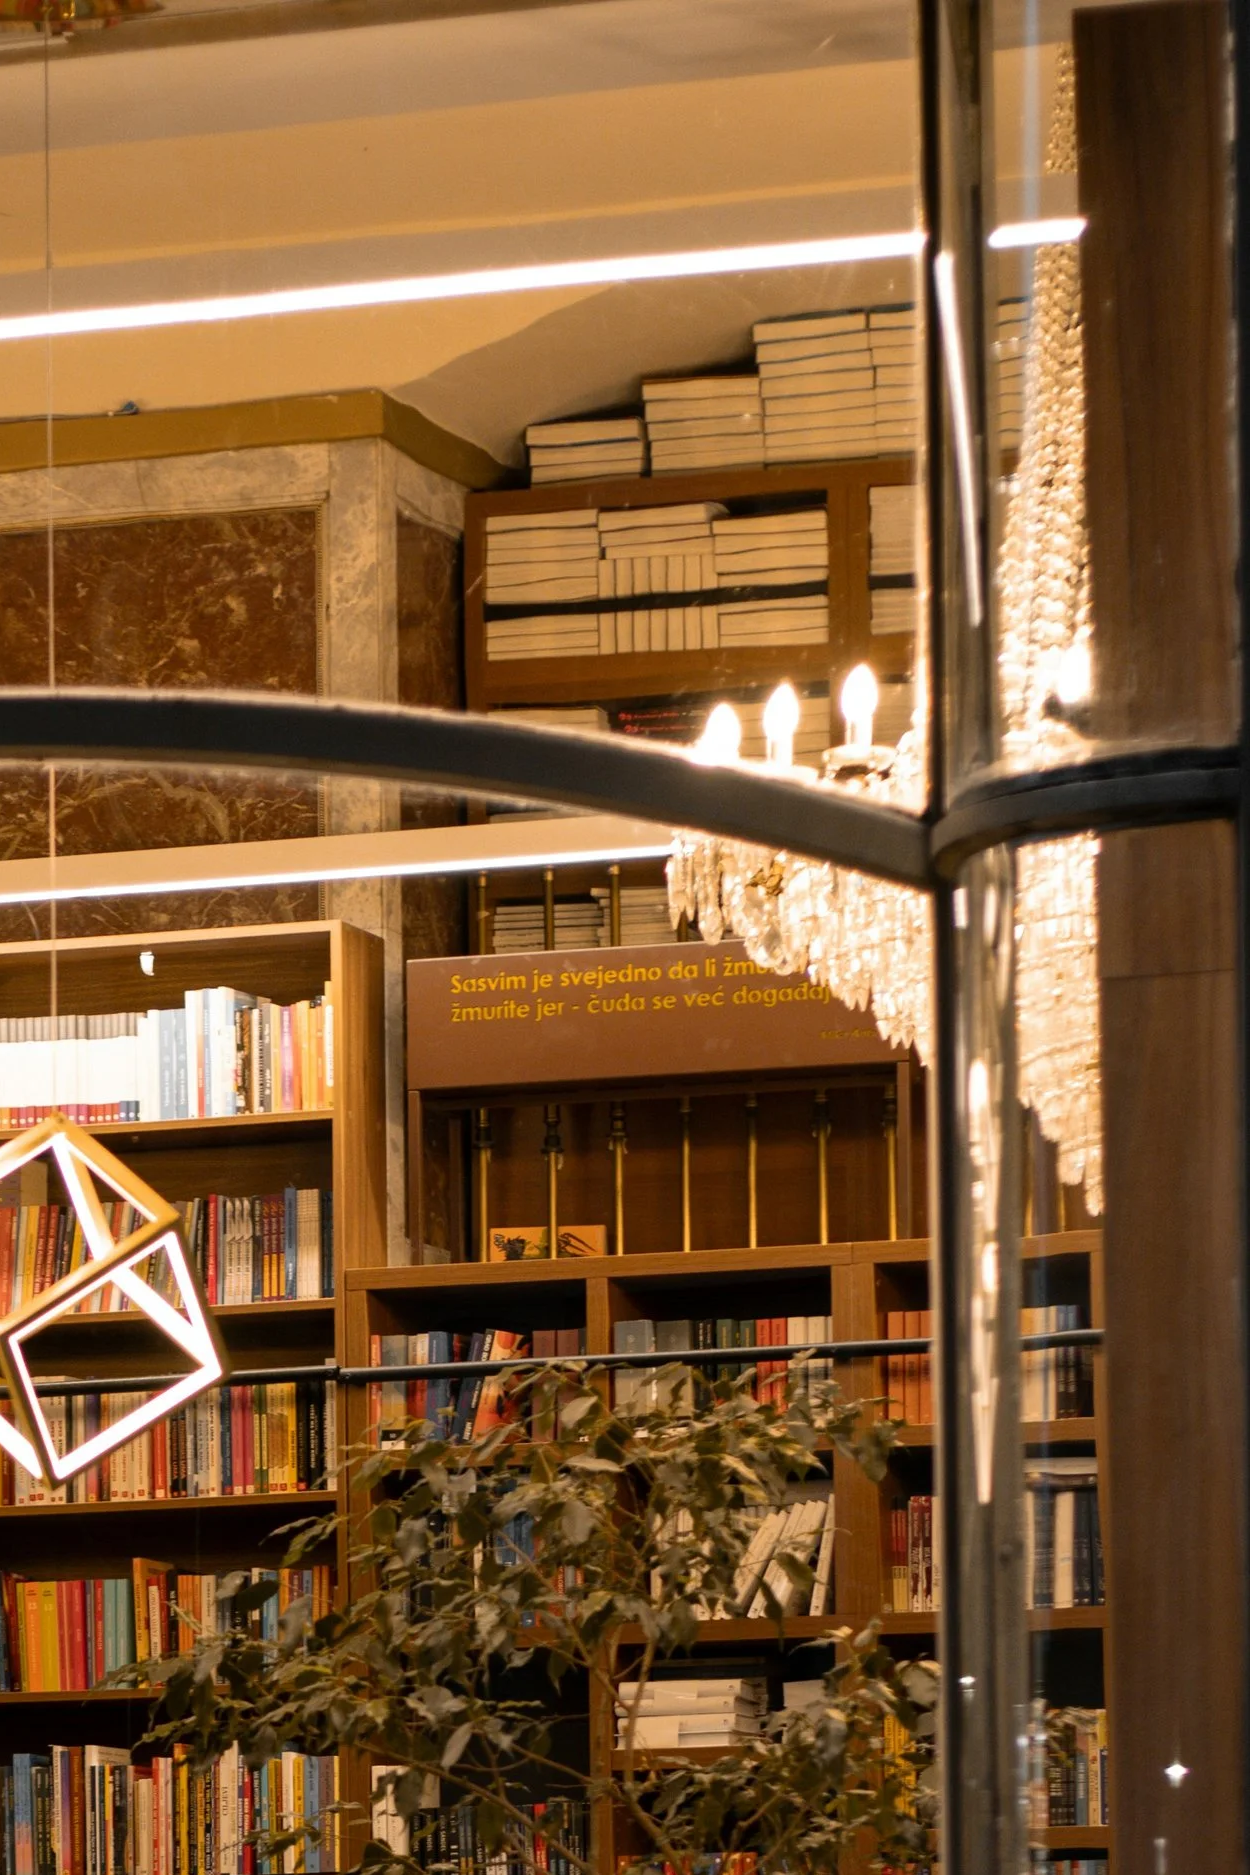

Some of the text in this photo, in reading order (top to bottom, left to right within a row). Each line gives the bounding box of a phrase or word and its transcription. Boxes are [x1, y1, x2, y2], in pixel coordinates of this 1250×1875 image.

[451, 972, 526, 994] Sasvim
[532, 969, 553, 993] je
[560, 963, 661, 989] svejedno
[668, 960, 698, 980] da
[705, 958, 716, 977] li
[451, 1000, 530, 1022] žmurite
[535, 998, 564, 1021] jer
[587, 993, 645, 1013] čuda
[653, 994, 677, 1010] se
[684, 985, 725, 1007] već
